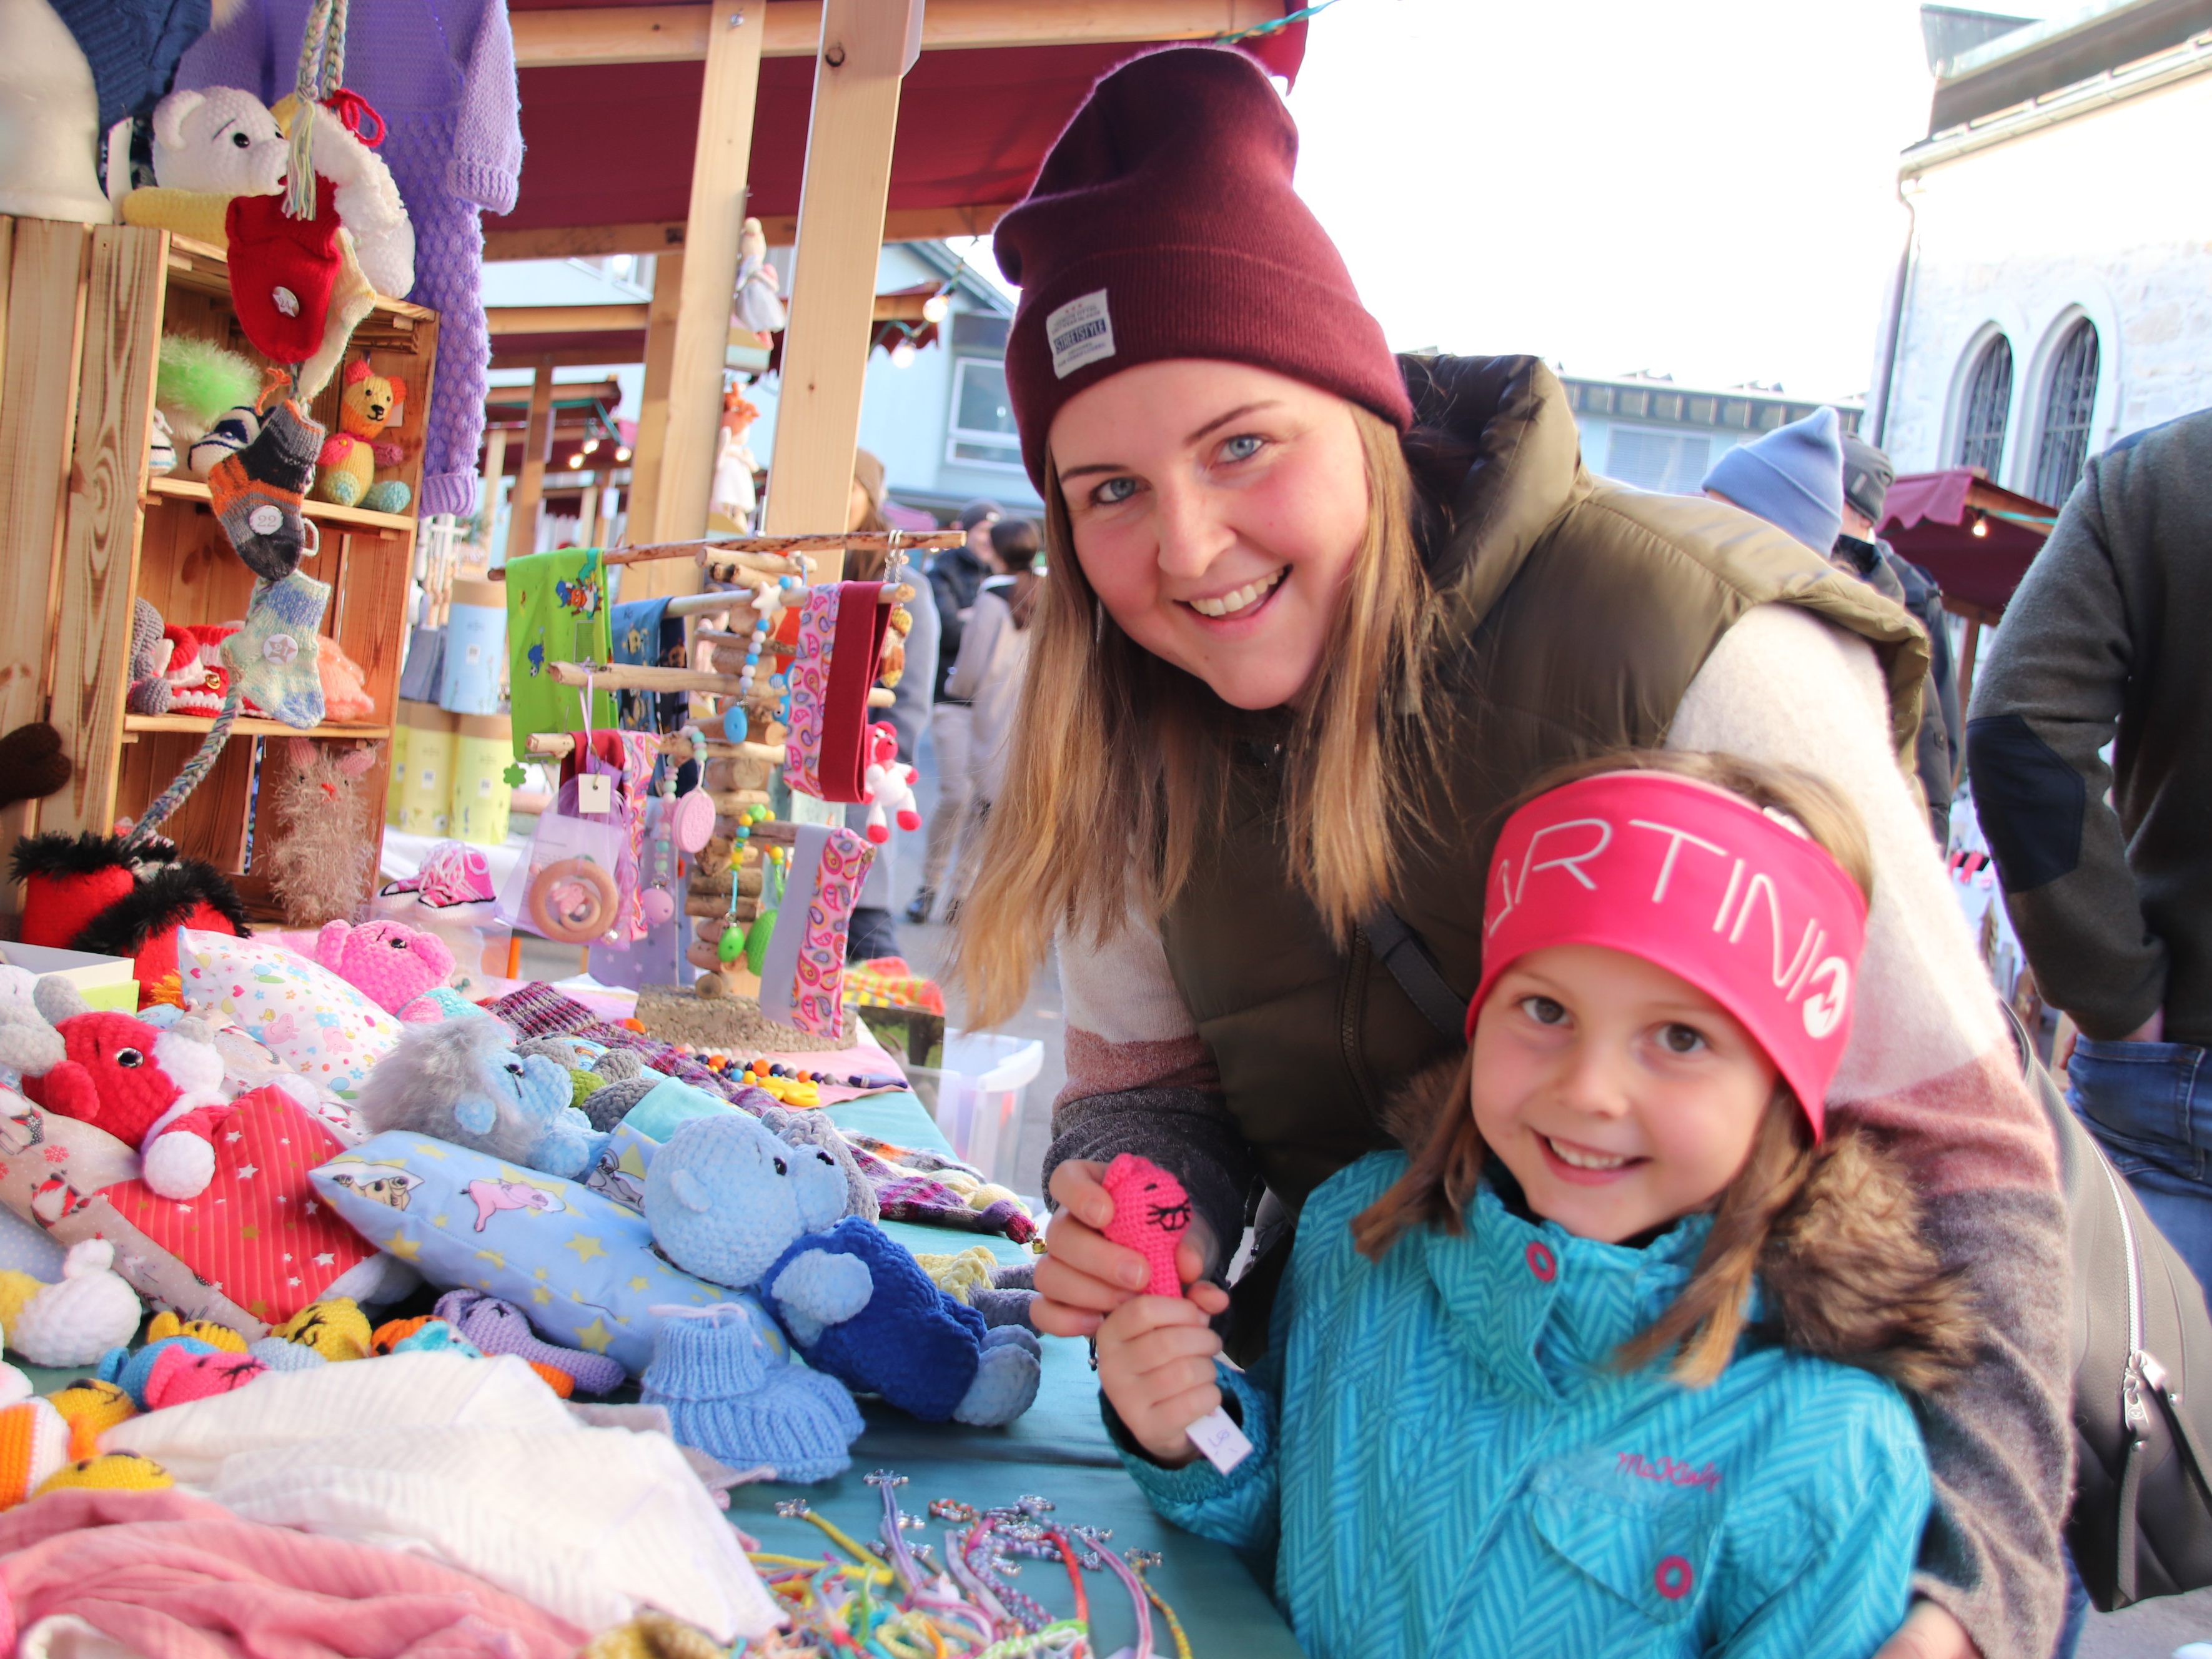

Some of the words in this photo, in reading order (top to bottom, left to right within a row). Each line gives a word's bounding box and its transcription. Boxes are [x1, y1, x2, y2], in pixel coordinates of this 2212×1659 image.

[279, 296, 291, 310] 24
[258, 515, 277, 527] 22
[272, 641, 289, 656] 21
